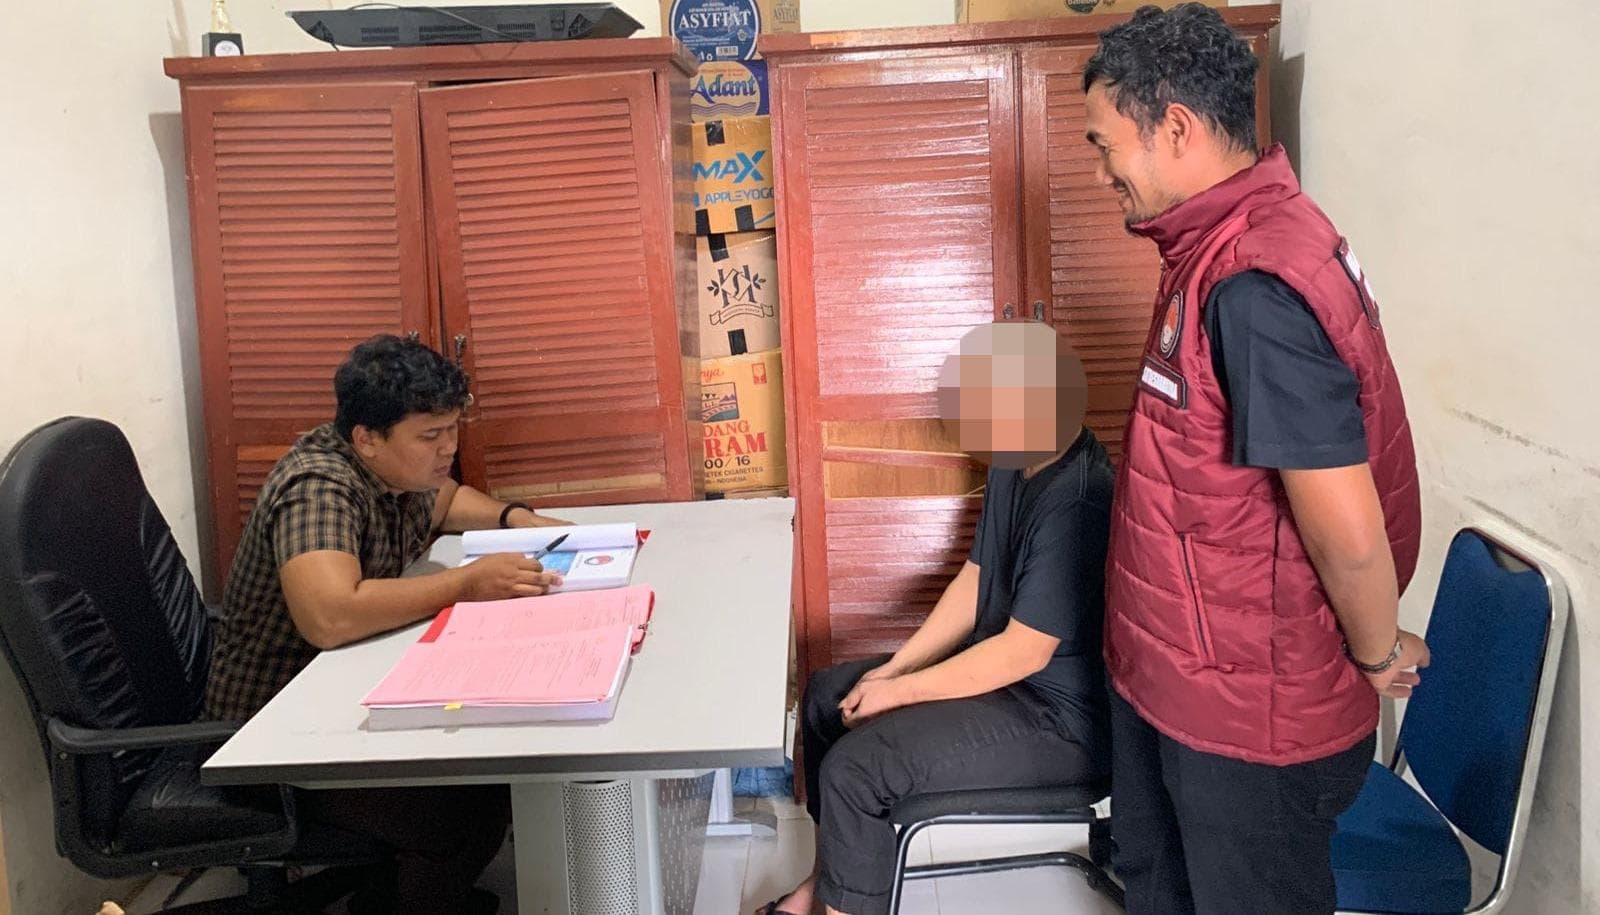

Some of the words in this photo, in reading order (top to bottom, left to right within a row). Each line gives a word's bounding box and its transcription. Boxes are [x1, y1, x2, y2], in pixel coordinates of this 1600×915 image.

[679, 11, 751, 29] ASYFIAT
[690, 74, 757, 104] Adant
[703, 420, 750, 438] DANG
[704, 432, 768, 458] RAM
[704, 455, 750, 469] 00/16
